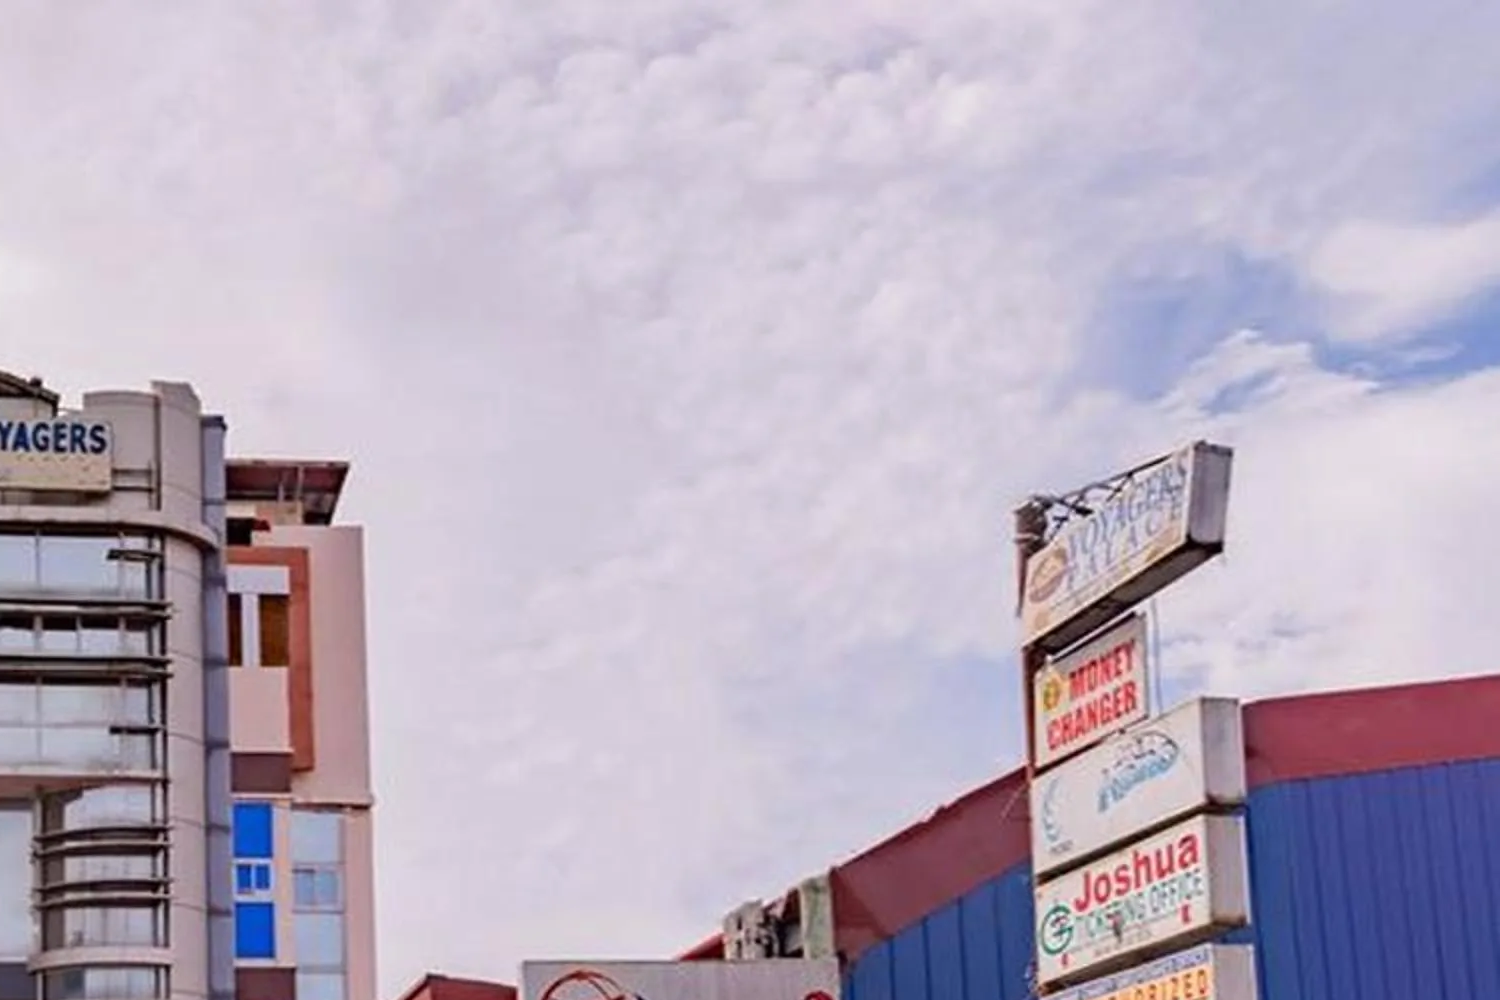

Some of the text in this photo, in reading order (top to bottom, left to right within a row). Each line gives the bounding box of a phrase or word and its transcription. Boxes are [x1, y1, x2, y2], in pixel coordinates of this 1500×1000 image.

[1068, 638, 1136, 699] MONEY
[1046, 681, 1137, 752] CHANGER
[1073, 832, 1198, 913] Joshua
[1150, 868, 1204, 914] OFFICE
